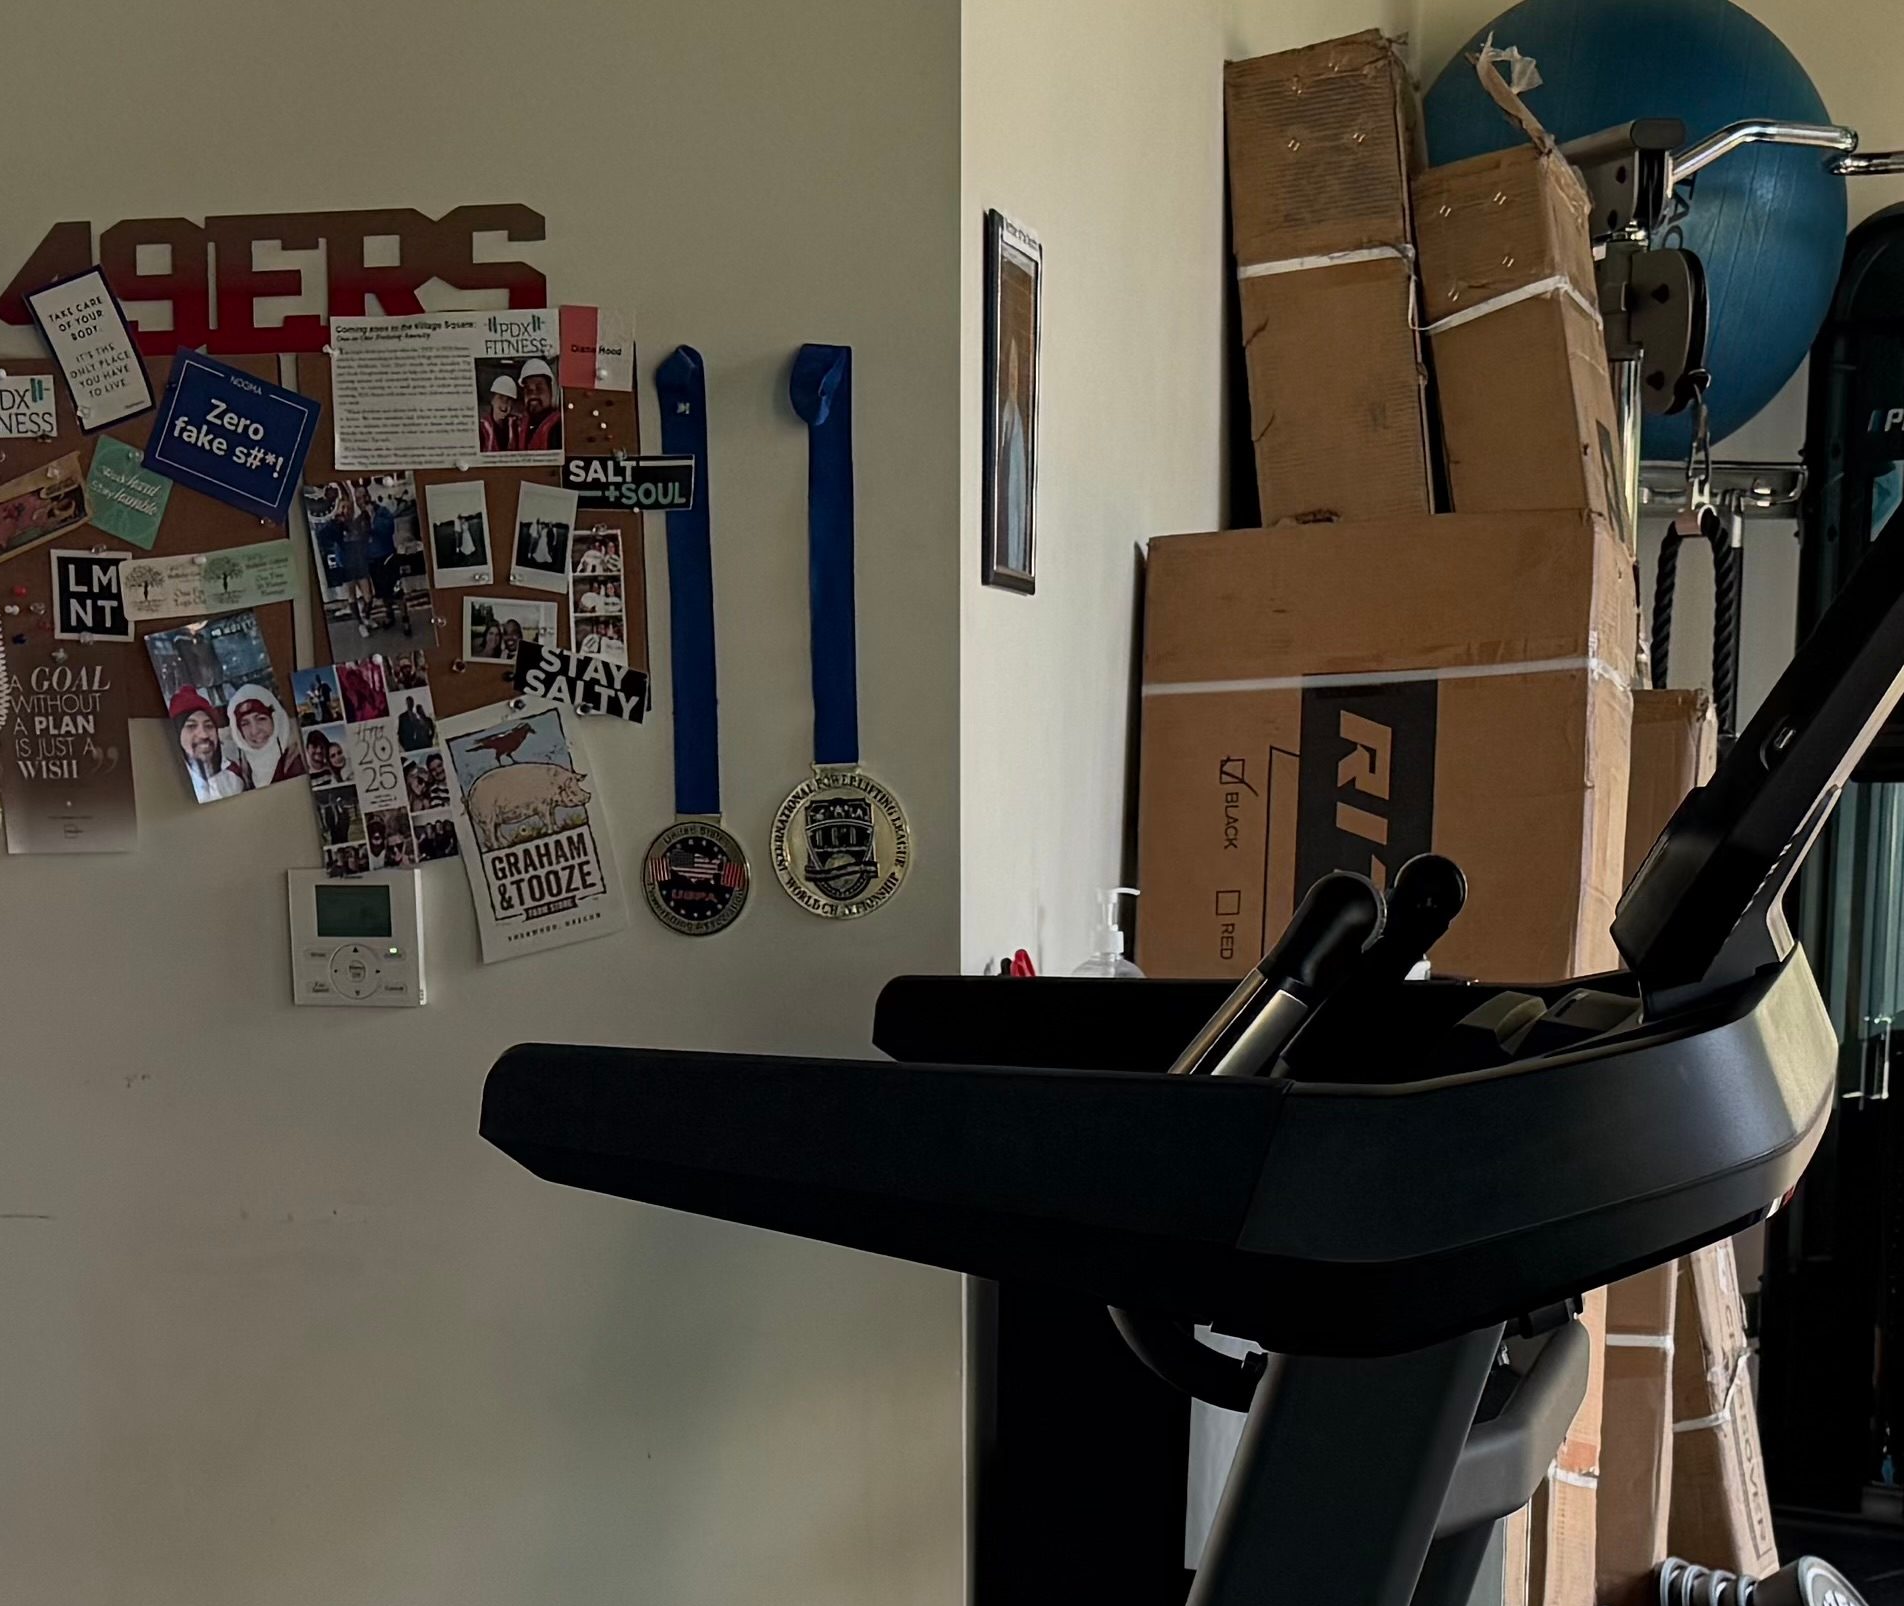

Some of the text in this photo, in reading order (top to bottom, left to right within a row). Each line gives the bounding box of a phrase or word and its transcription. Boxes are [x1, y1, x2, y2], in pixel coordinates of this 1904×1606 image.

[49, 296, 103, 322] TAKE CARE
[59, 310, 103, 332] OF YOUR
[96, 343, 115, 356] THE
[499, 332, 531, 347] PDX
[70, 351, 130, 379] ONLY PLACE
[485, 349, 548, 365] FITNESS
[80, 365, 129, 387] YOU HAVE
[89, 387, 102, 397] TO
[206, 398, 264, 441] Zero
[173, 416, 228, 456] fake
[569, 460, 636, 482] SALT
[605, 482, 686, 505] +SOUL
[9, 665, 111, 693] A GOAL
[539, 647, 629, 690] STAY
[10, 694, 102, 714] WITHOUT
[523, 669, 639, 720] SALTY
[13, 715, 95, 735] A PLAN
[16, 736, 97, 759] IS JUST A
[16, 760, 79, 780] WISH
[1338, 710, 1392, 886] RI
[1223, 791, 1238, 849] BLACK
[891, 816, 908, 868] LEAGUE
[491, 832, 588, 881] GRAHAM
[498, 860, 597, 911] &TOOZE
[786, 875, 821, 911] WORLD
[1220, 922, 1235, 961] RED
